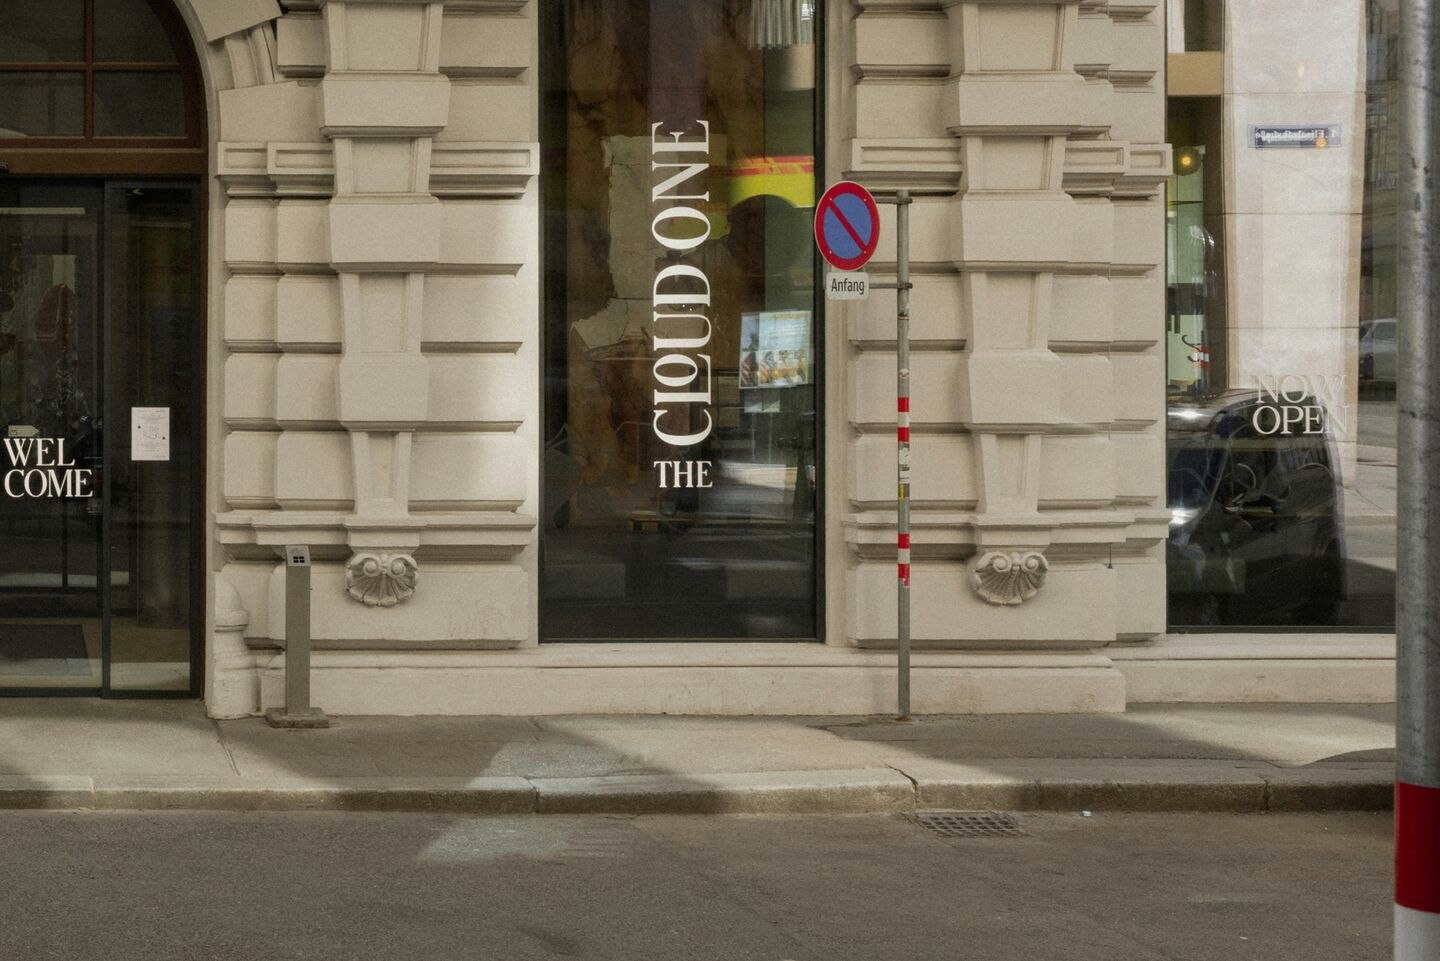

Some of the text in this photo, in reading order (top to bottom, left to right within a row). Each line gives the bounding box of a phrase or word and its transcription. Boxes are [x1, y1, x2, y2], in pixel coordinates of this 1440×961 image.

[831, 278, 865, 295] Anfang
[651, 119, 713, 488] THE CLOUD ONE
[1255, 374, 1347, 404] NOW
[1252, 405, 1350, 435] OPEN
[3, 438, 75, 467] WEL
[4, 468, 93, 498] COME
